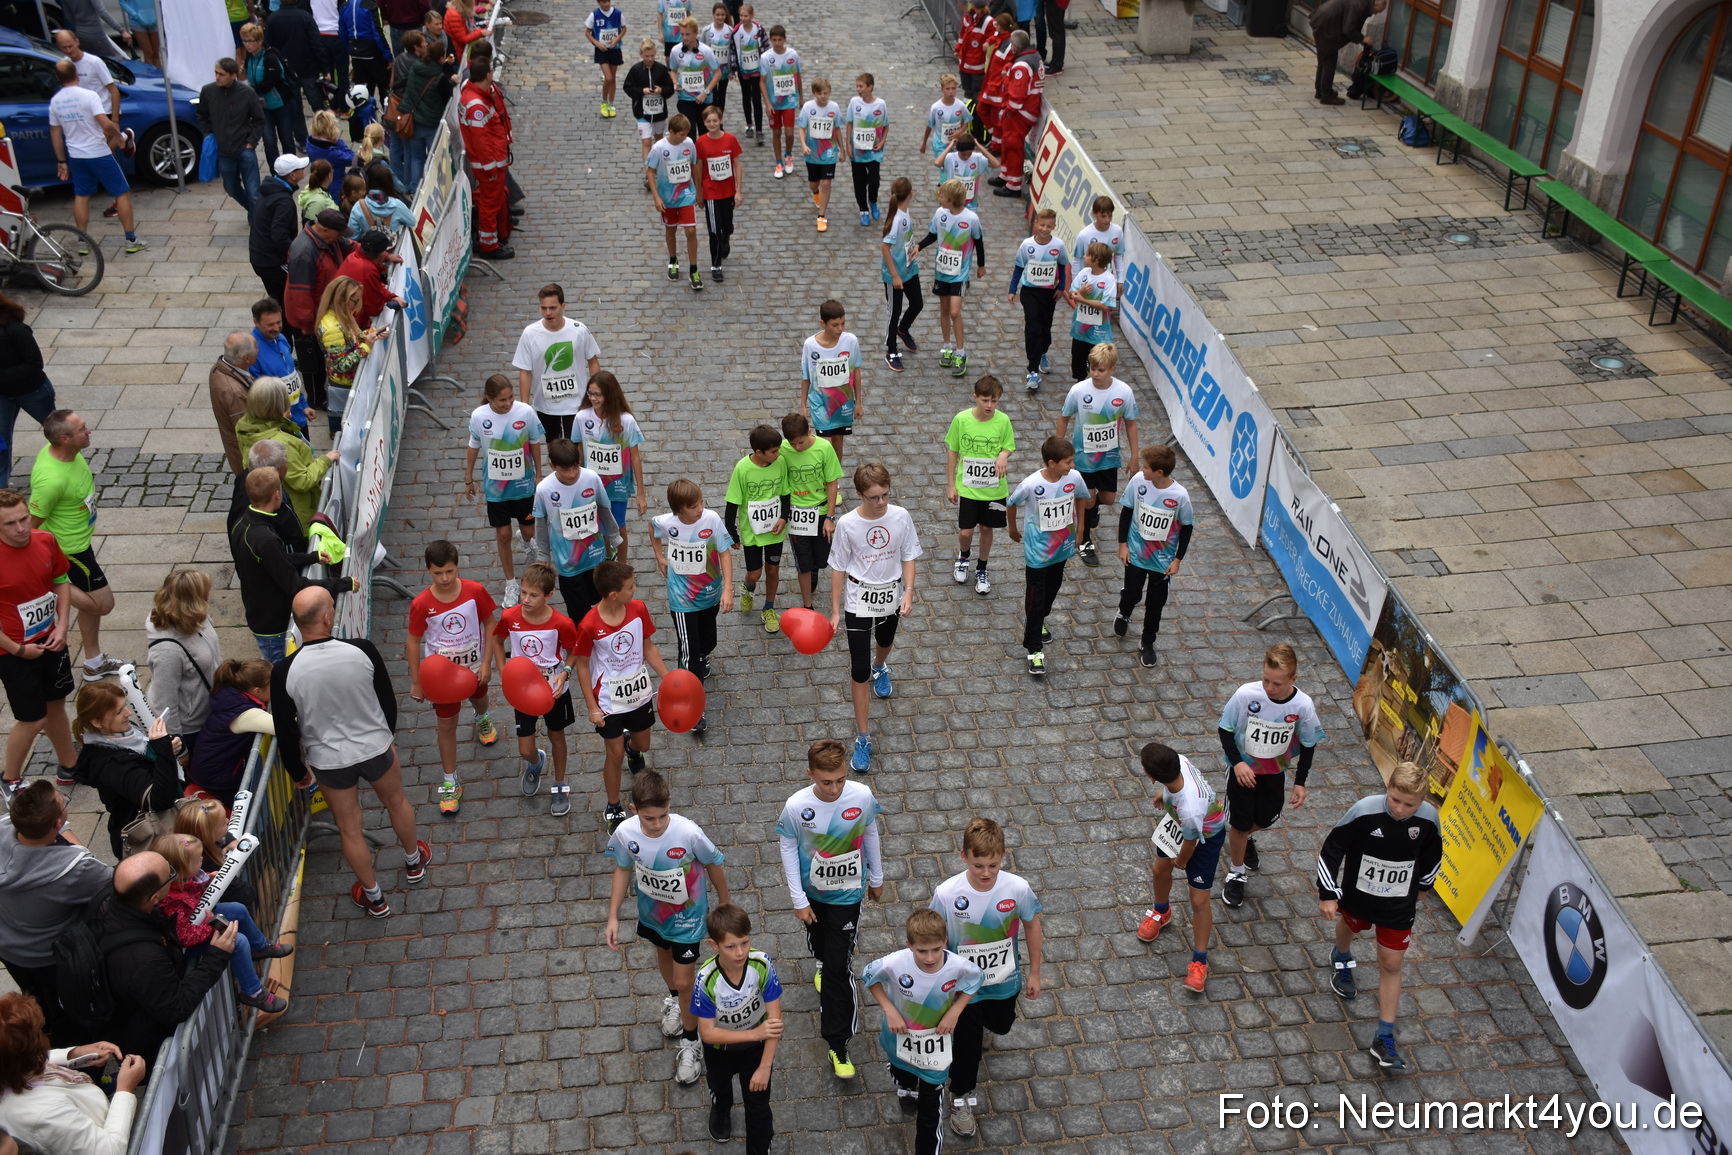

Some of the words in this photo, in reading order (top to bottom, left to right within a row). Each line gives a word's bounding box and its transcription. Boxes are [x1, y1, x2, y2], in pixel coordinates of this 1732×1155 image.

[776, 79, 794, 88] 4003
[812, 122, 832, 131] 4112
[11, 130, 48, 141] PARTL
[856, 133, 875, 142] 4105
[670, 164, 690, 176] 4045
[710, 159, 730, 172] 4026
[938, 254, 960, 266] 4015
[1030, 266, 1054, 276] 4042
[820, 363, 846, 376] 4004
[546, 379, 575, 392] 4109
[1087, 429, 1115, 442] 4030
[492, 457, 522, 469] 4019
[590, 450, 619, 463] 4046
[967, 465, 995, 477] 4029
[752, 505, 779, 521] 4047
[1044, 502, 1072, 518] 4117
[566, 511, 595, 528] 4014
[1140, 513, 1169, 529] 4000
[672, 549, 703, 562] 4116
[1264, 506, 1281, 531] AUF
[1327, 602, 1364, 668] ZUHAUSE
[861, 591, 893, 604] 4035
[26, 600, 55, 626] 2049
[615, 676, 647, 698] 4040
[1250, 728, 1290, 745] 4106
[1457, 791, 1468, 813] Die
[1465, 809, 1484, 837] passen
[1461, 779, 1483, 817] Systeme
[1481, 811, 1493, 831] von
[1490, 827, 1508, 859] KANN:
[1498, 805, 1522, 848] KANN
[815, 861, 857, 878] 4005
[1364, 867, 1408, 884] 4100
[641, 874, 682, 893] 4022
[1367, 882, 1392, 894] FELIX
[190, 857, 240, 924] bmw-laufspo
[651, 890, 675, 900] Jannick
[959, 947, 978, 955] PARTL
[979, 945, 1005, 953] Neumarkt
[719, 998, 761, 1023] 4036
[735, 1020, 752, 1029] Jens
[903, 1036, 945, 1055] 4101
